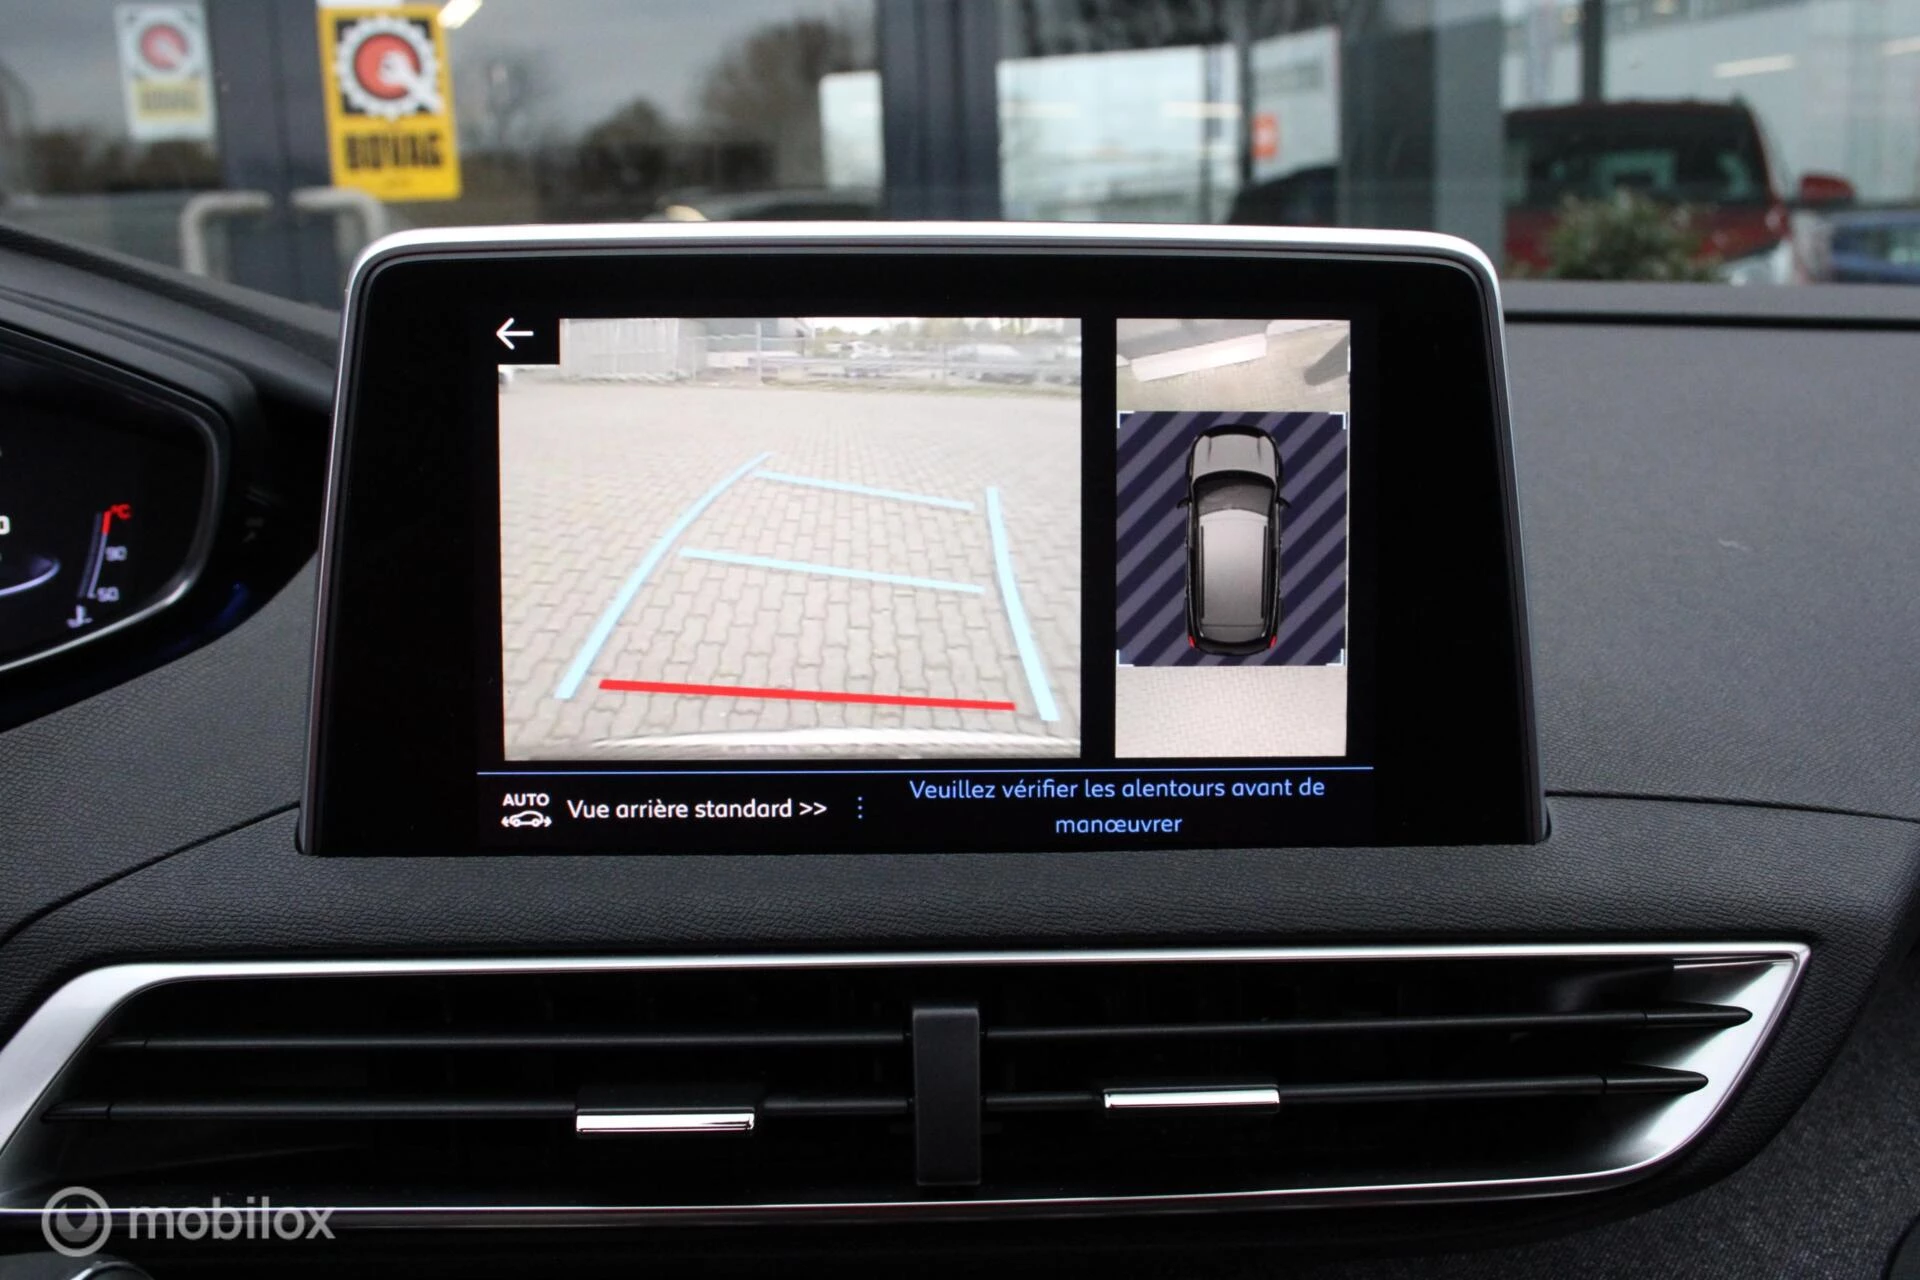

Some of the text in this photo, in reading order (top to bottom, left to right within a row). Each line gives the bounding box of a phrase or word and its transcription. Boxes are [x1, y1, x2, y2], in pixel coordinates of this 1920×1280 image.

[909, 776, 1326, 799] Veuillez vérifier les alentours avant de
[502, 792, 550, 807] AUTO
[566, 799, 610, 819] Vue
[615, 798, 689, 819] arrière
[694, 797, 793, 819] standard
[1055, 817, 1183, 835] manœuvrer
